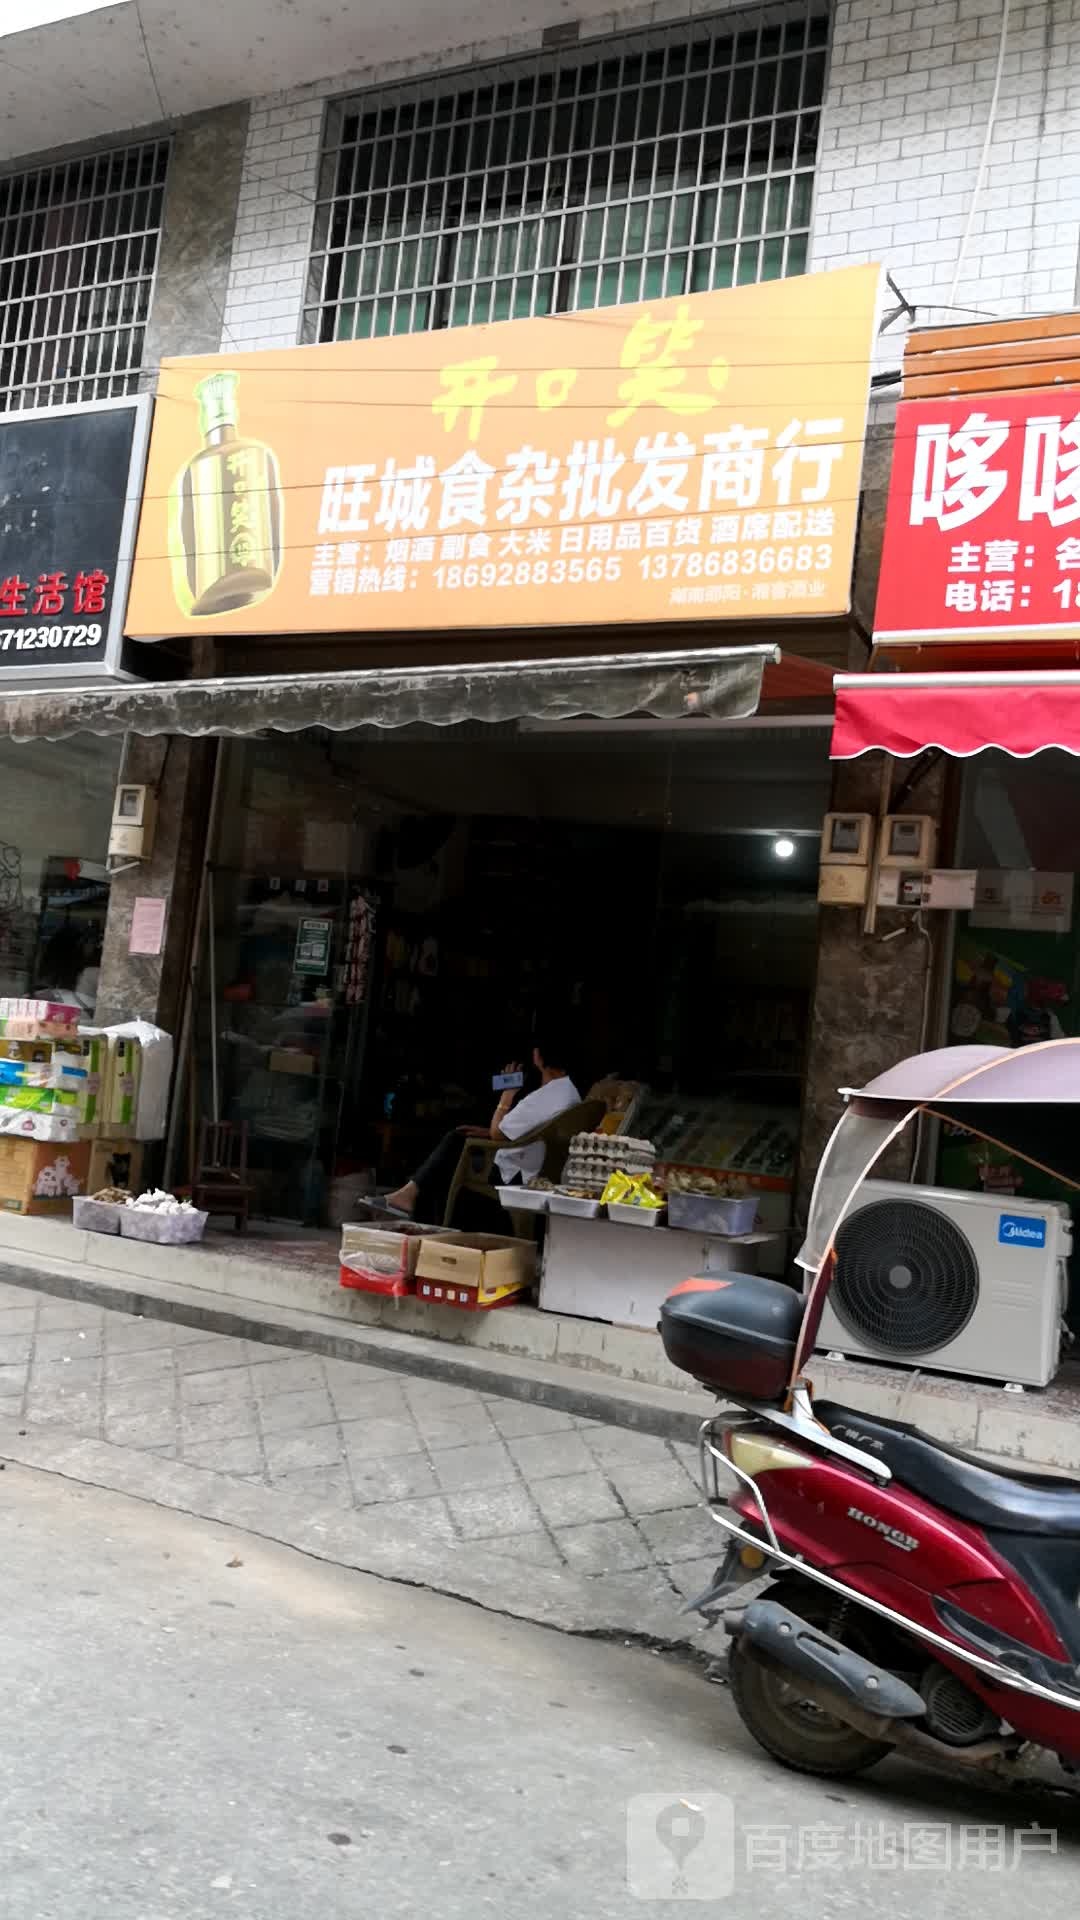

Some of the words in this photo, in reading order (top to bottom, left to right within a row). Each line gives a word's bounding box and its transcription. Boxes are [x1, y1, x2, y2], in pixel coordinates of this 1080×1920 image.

[318, 418, 845, 534] 旺城食杂批发商行
[440, 533, 492, 560] 副食
[498, 529, 552, 556] 大米
[559, 517, 703, 553] 日用品百货
[709, 507, 836, 544] 酒席配送
[432, 556, 622, 590] 18692883565
[638, 544, 833, 580] 13786836683
[0, 569, 109, 617] 生活馆
[0, 623, 102, 651] 71230729
